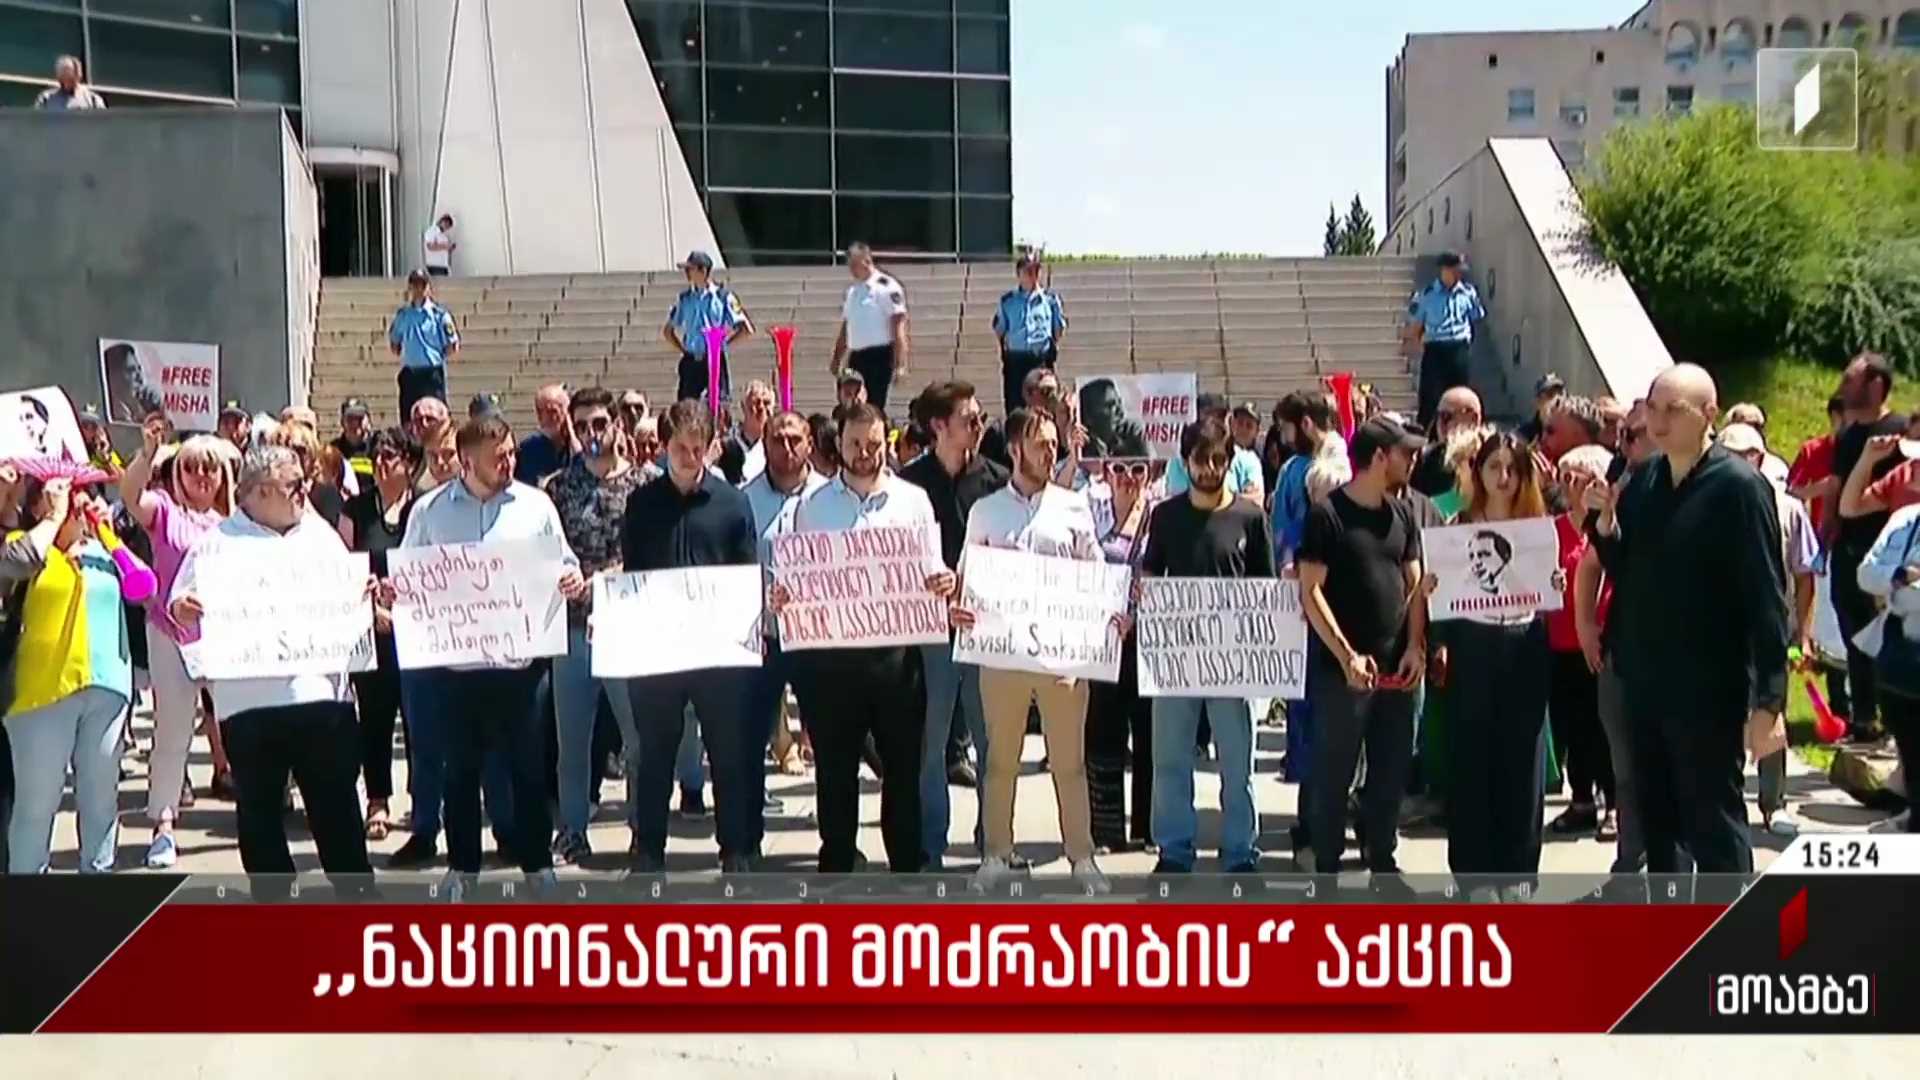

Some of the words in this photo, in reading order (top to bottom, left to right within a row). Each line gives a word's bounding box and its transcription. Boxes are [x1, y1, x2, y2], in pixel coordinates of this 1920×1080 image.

[162, 366, 212, 388] #FREE
[164, 392, 210, 414] MISHA
[1142, 395, 1189, 416] #FREE
[1143, 422, 1182, 443] MISH
[978, 626, 1017, 656] visit
